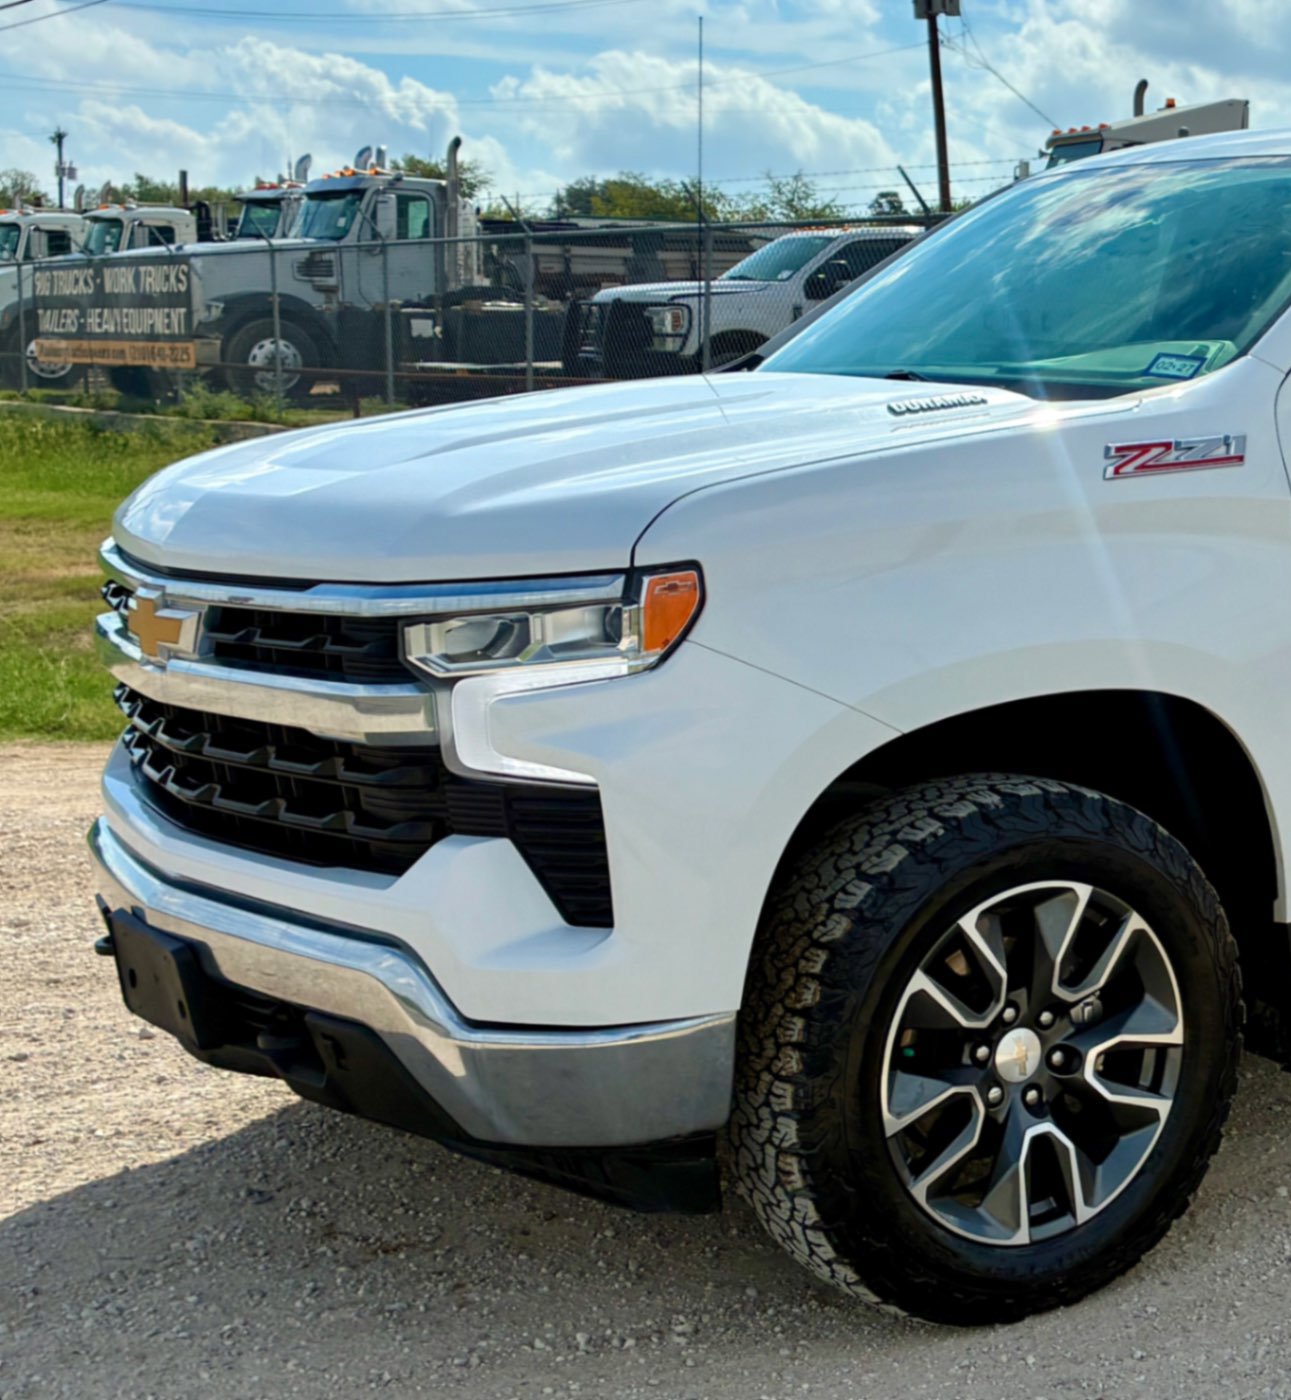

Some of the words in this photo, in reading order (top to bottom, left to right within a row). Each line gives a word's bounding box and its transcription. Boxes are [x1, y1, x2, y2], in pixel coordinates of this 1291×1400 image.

[53, 268, 95, 296] TRUCKS
[103, 266, 136, 294] WORK
[139, 264, 189, 294] TRUCKS
[122, 307, 187, 335] EQUIPMENT
[1103, 434, 1247, 480] Z71
